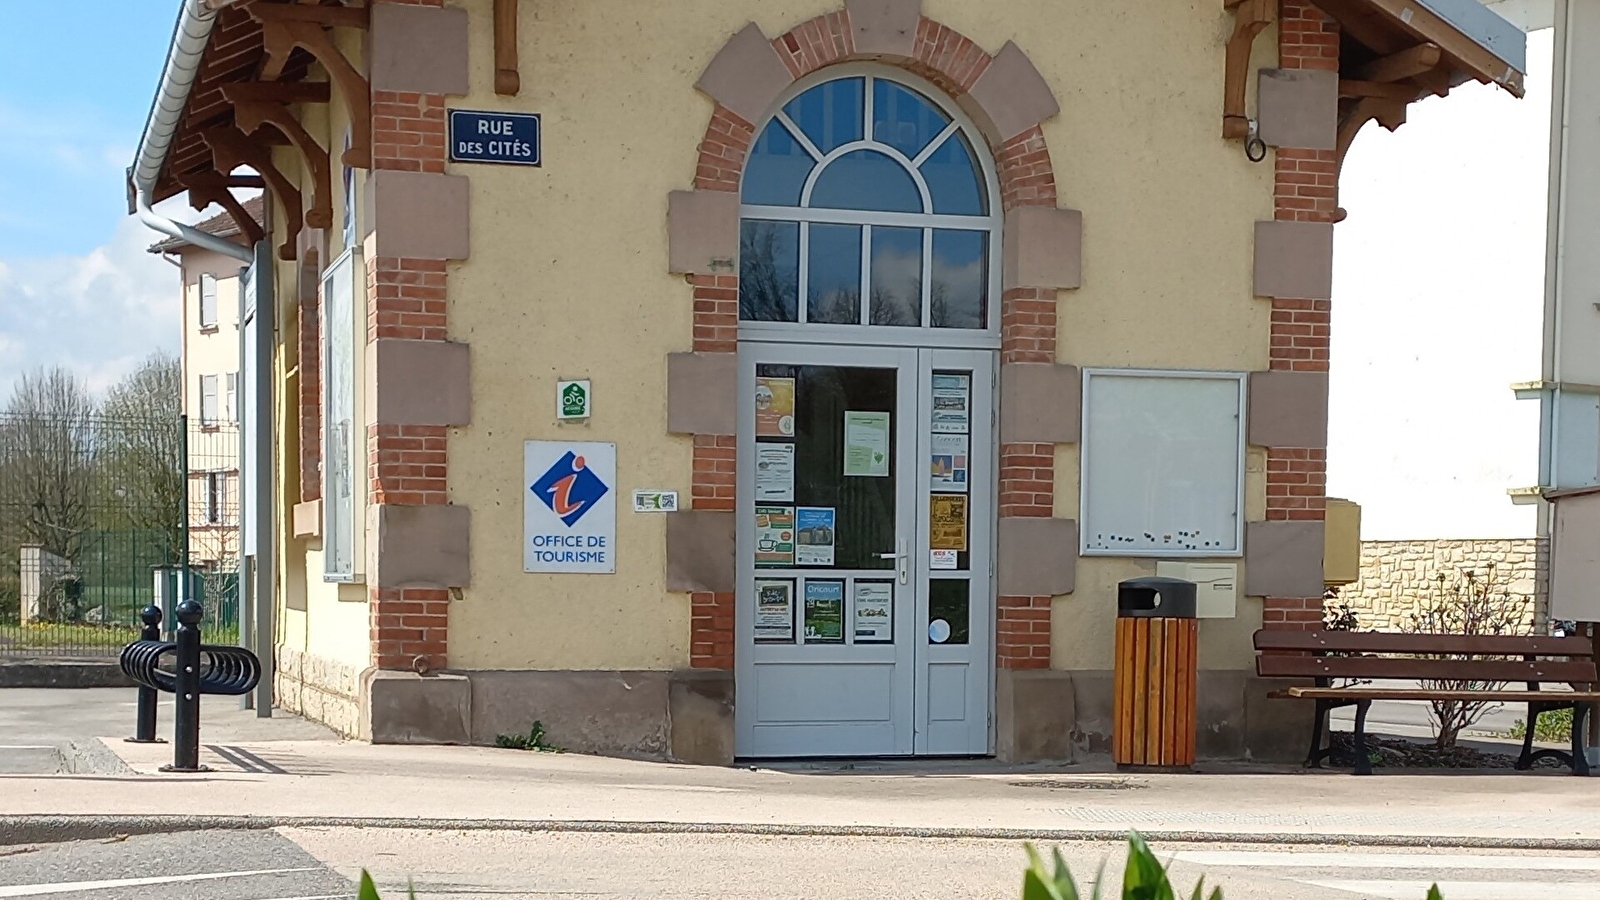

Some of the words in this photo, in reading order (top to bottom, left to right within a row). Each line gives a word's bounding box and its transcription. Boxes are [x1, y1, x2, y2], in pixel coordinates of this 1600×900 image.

[478, 120, 513, 135] RUE
[459, 141, 483, 154] DES
[488, 139, 531, 156] CITÉS
[533, 535, 583, 547] OFFICE
[587, 536, 606, 547] DE
[534, 551, 605, 563] TOURISME
